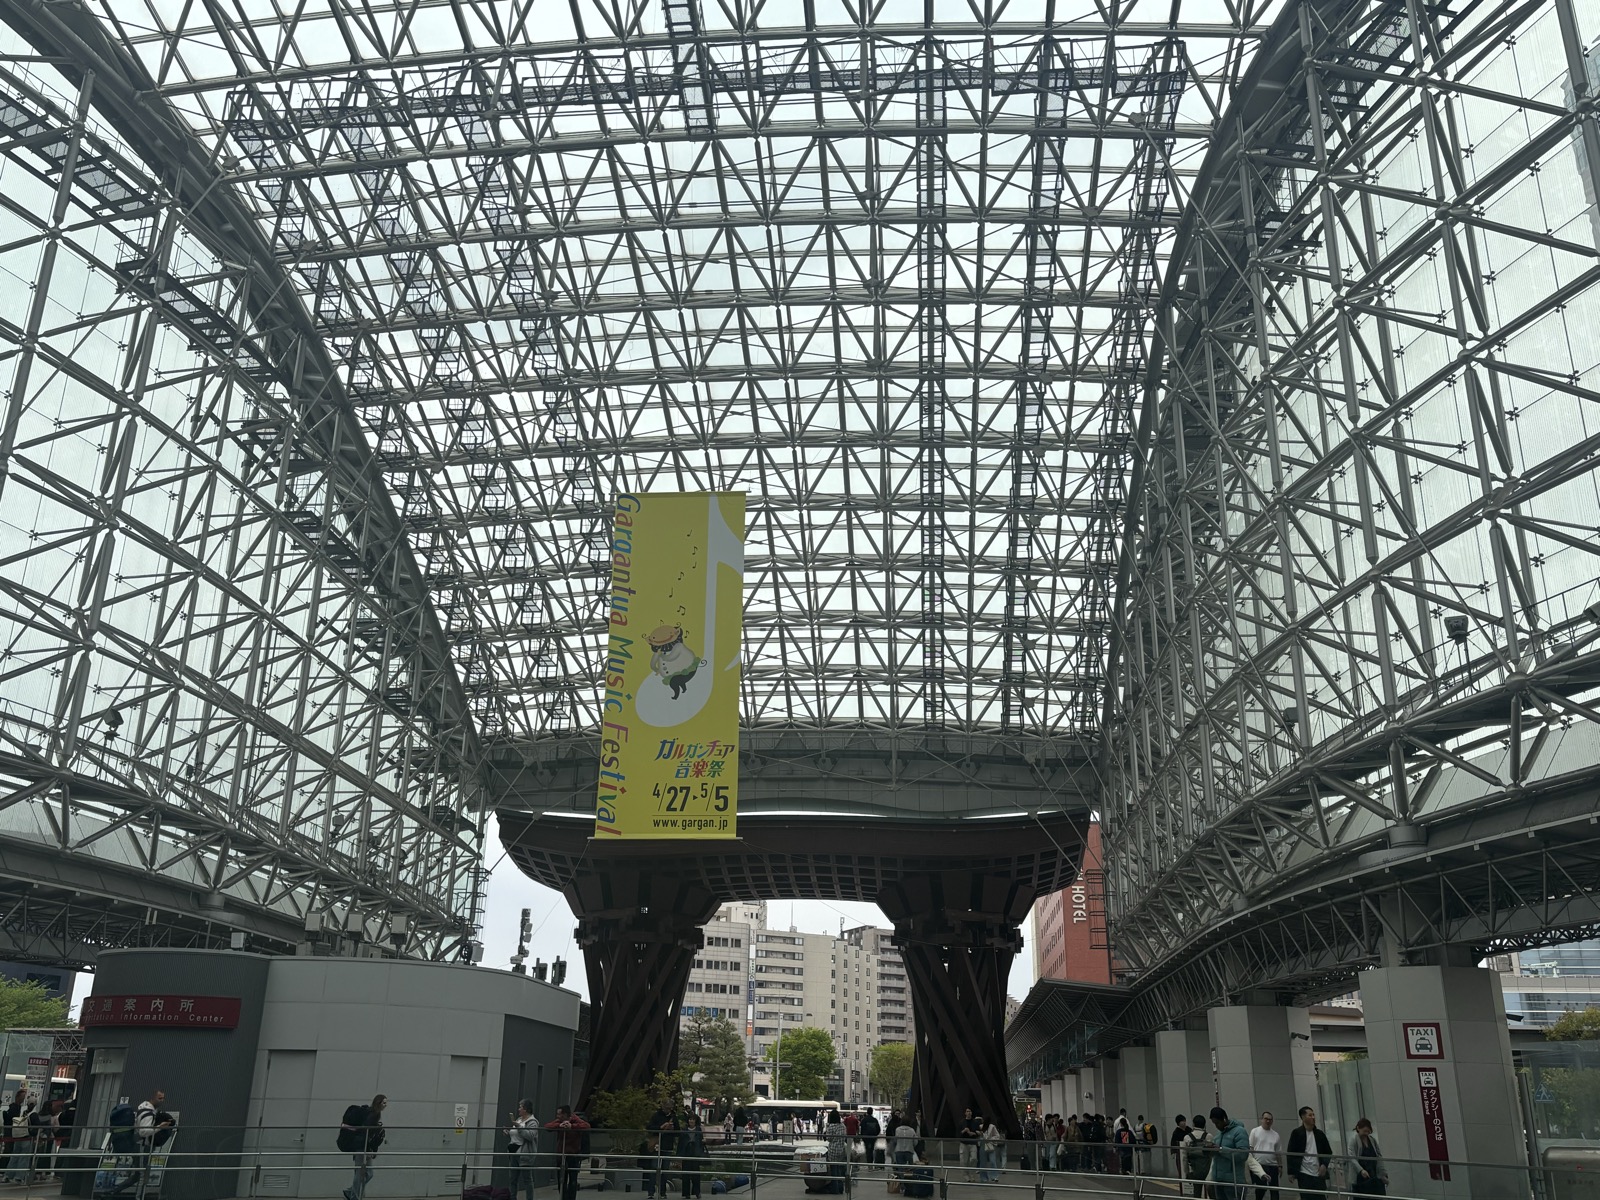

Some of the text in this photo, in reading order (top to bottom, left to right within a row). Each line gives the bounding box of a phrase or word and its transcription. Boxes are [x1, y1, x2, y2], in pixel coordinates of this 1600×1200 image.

[597, 494, 641, 836] Gargantua Music Festival
[654, 737, 736, 761] ガルガンチュア
[674, 758, 726, 778] 音楽祭
[653, 816, 728, 831] www.gargan.jp
[1071, 885, 1087, 924] HOTEL
[120, 1013, 179, 1021] Information
[189, 1014, 224, 1023] Center
[1409, 1028, 1434, 1036] TAXI
[1429, 1089, 1443, 1141] タクシーのりば
